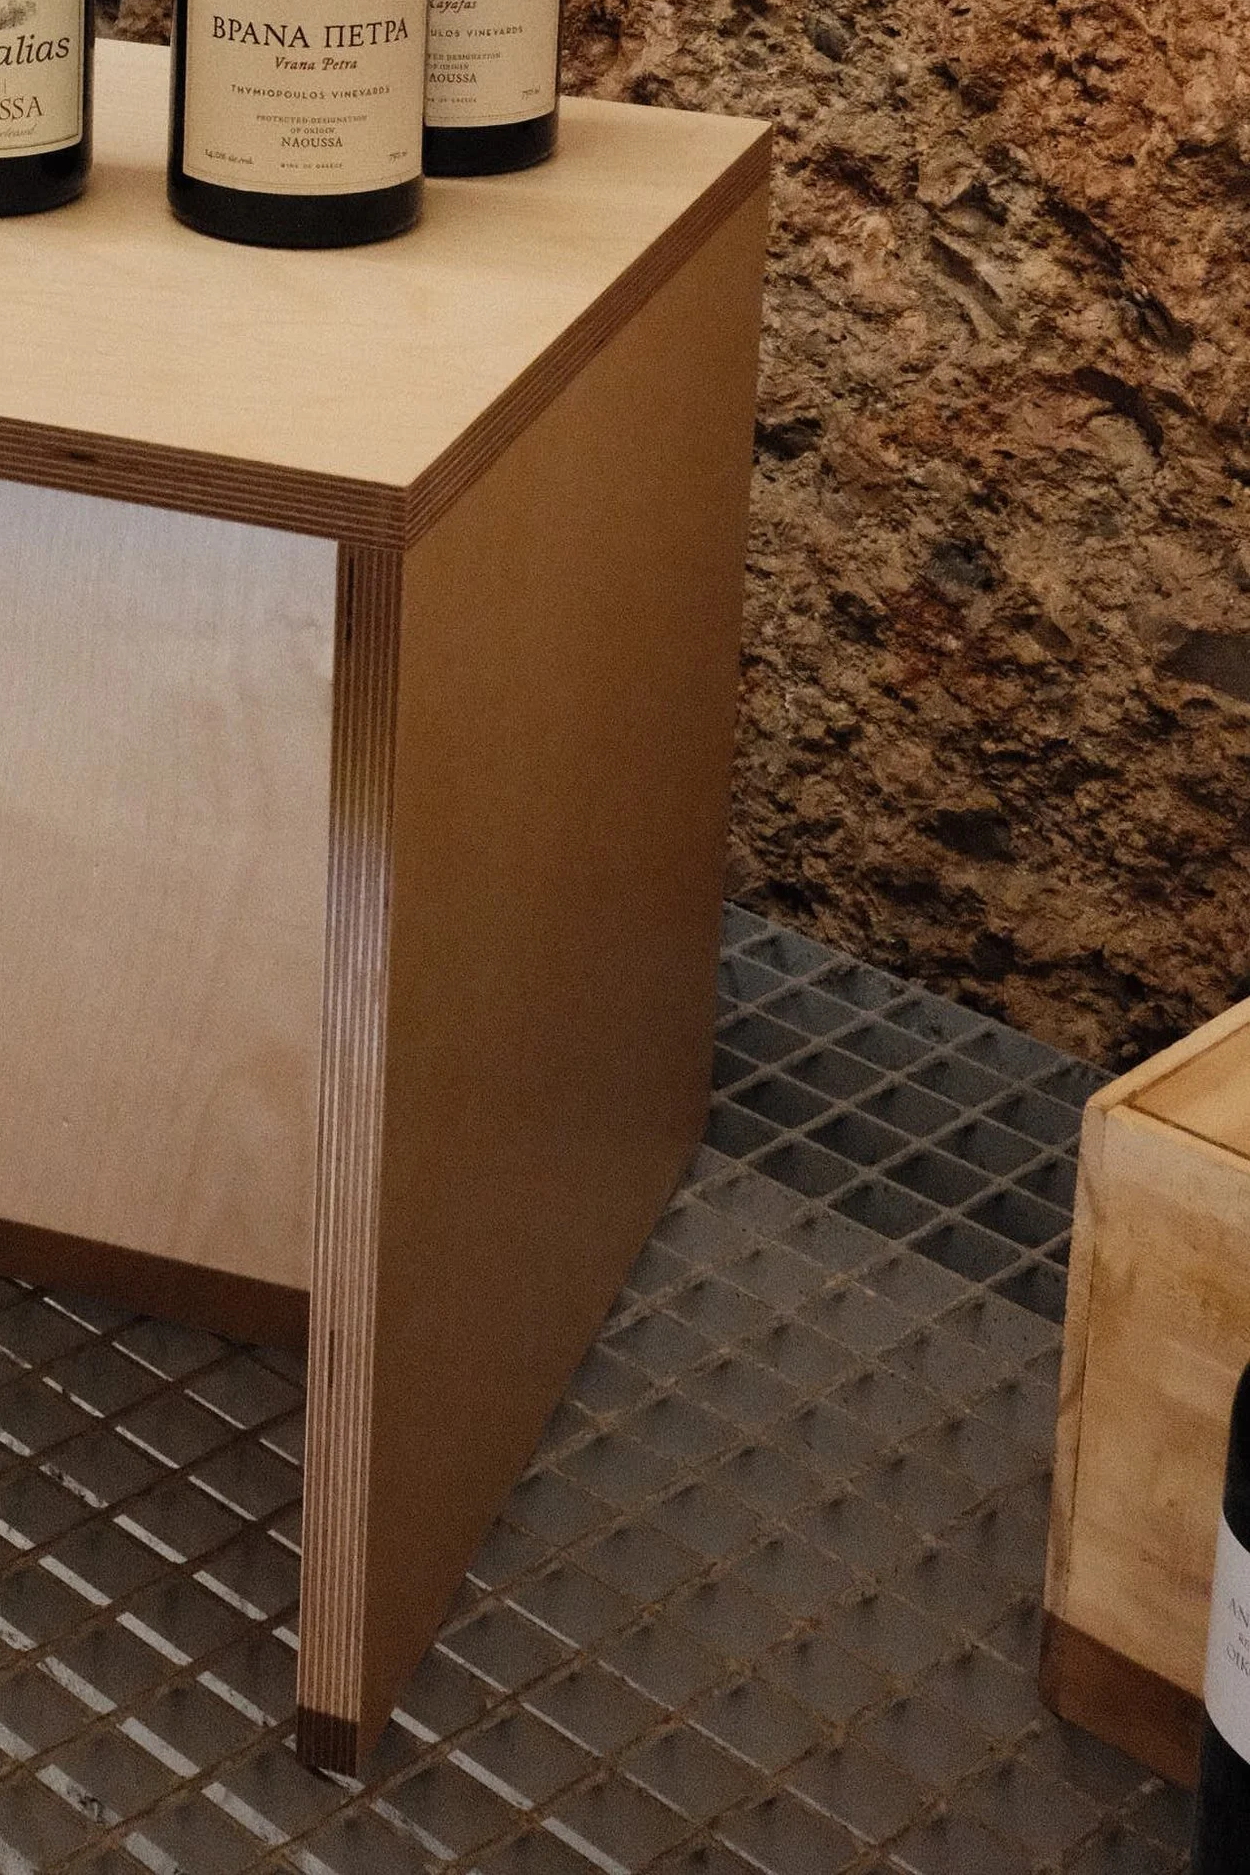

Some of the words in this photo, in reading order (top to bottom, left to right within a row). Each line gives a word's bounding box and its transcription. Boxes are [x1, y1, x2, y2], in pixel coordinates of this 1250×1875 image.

[212, 14, 311, 49] ΒΡΑΝΑ
[323, 16, 410, 49] ΠΕΤΡΑ
[466, 26, 524, 39] VINEYARDS
[275, 56, 316, 72] Vrana
[322, 56, 359, 72] Petra
[230, 83, 326, 101] THYMIOPOULOS
[331, 86, 391, 100] VINEYARDS
[280, 136, 343, 149] NAOUSSA
